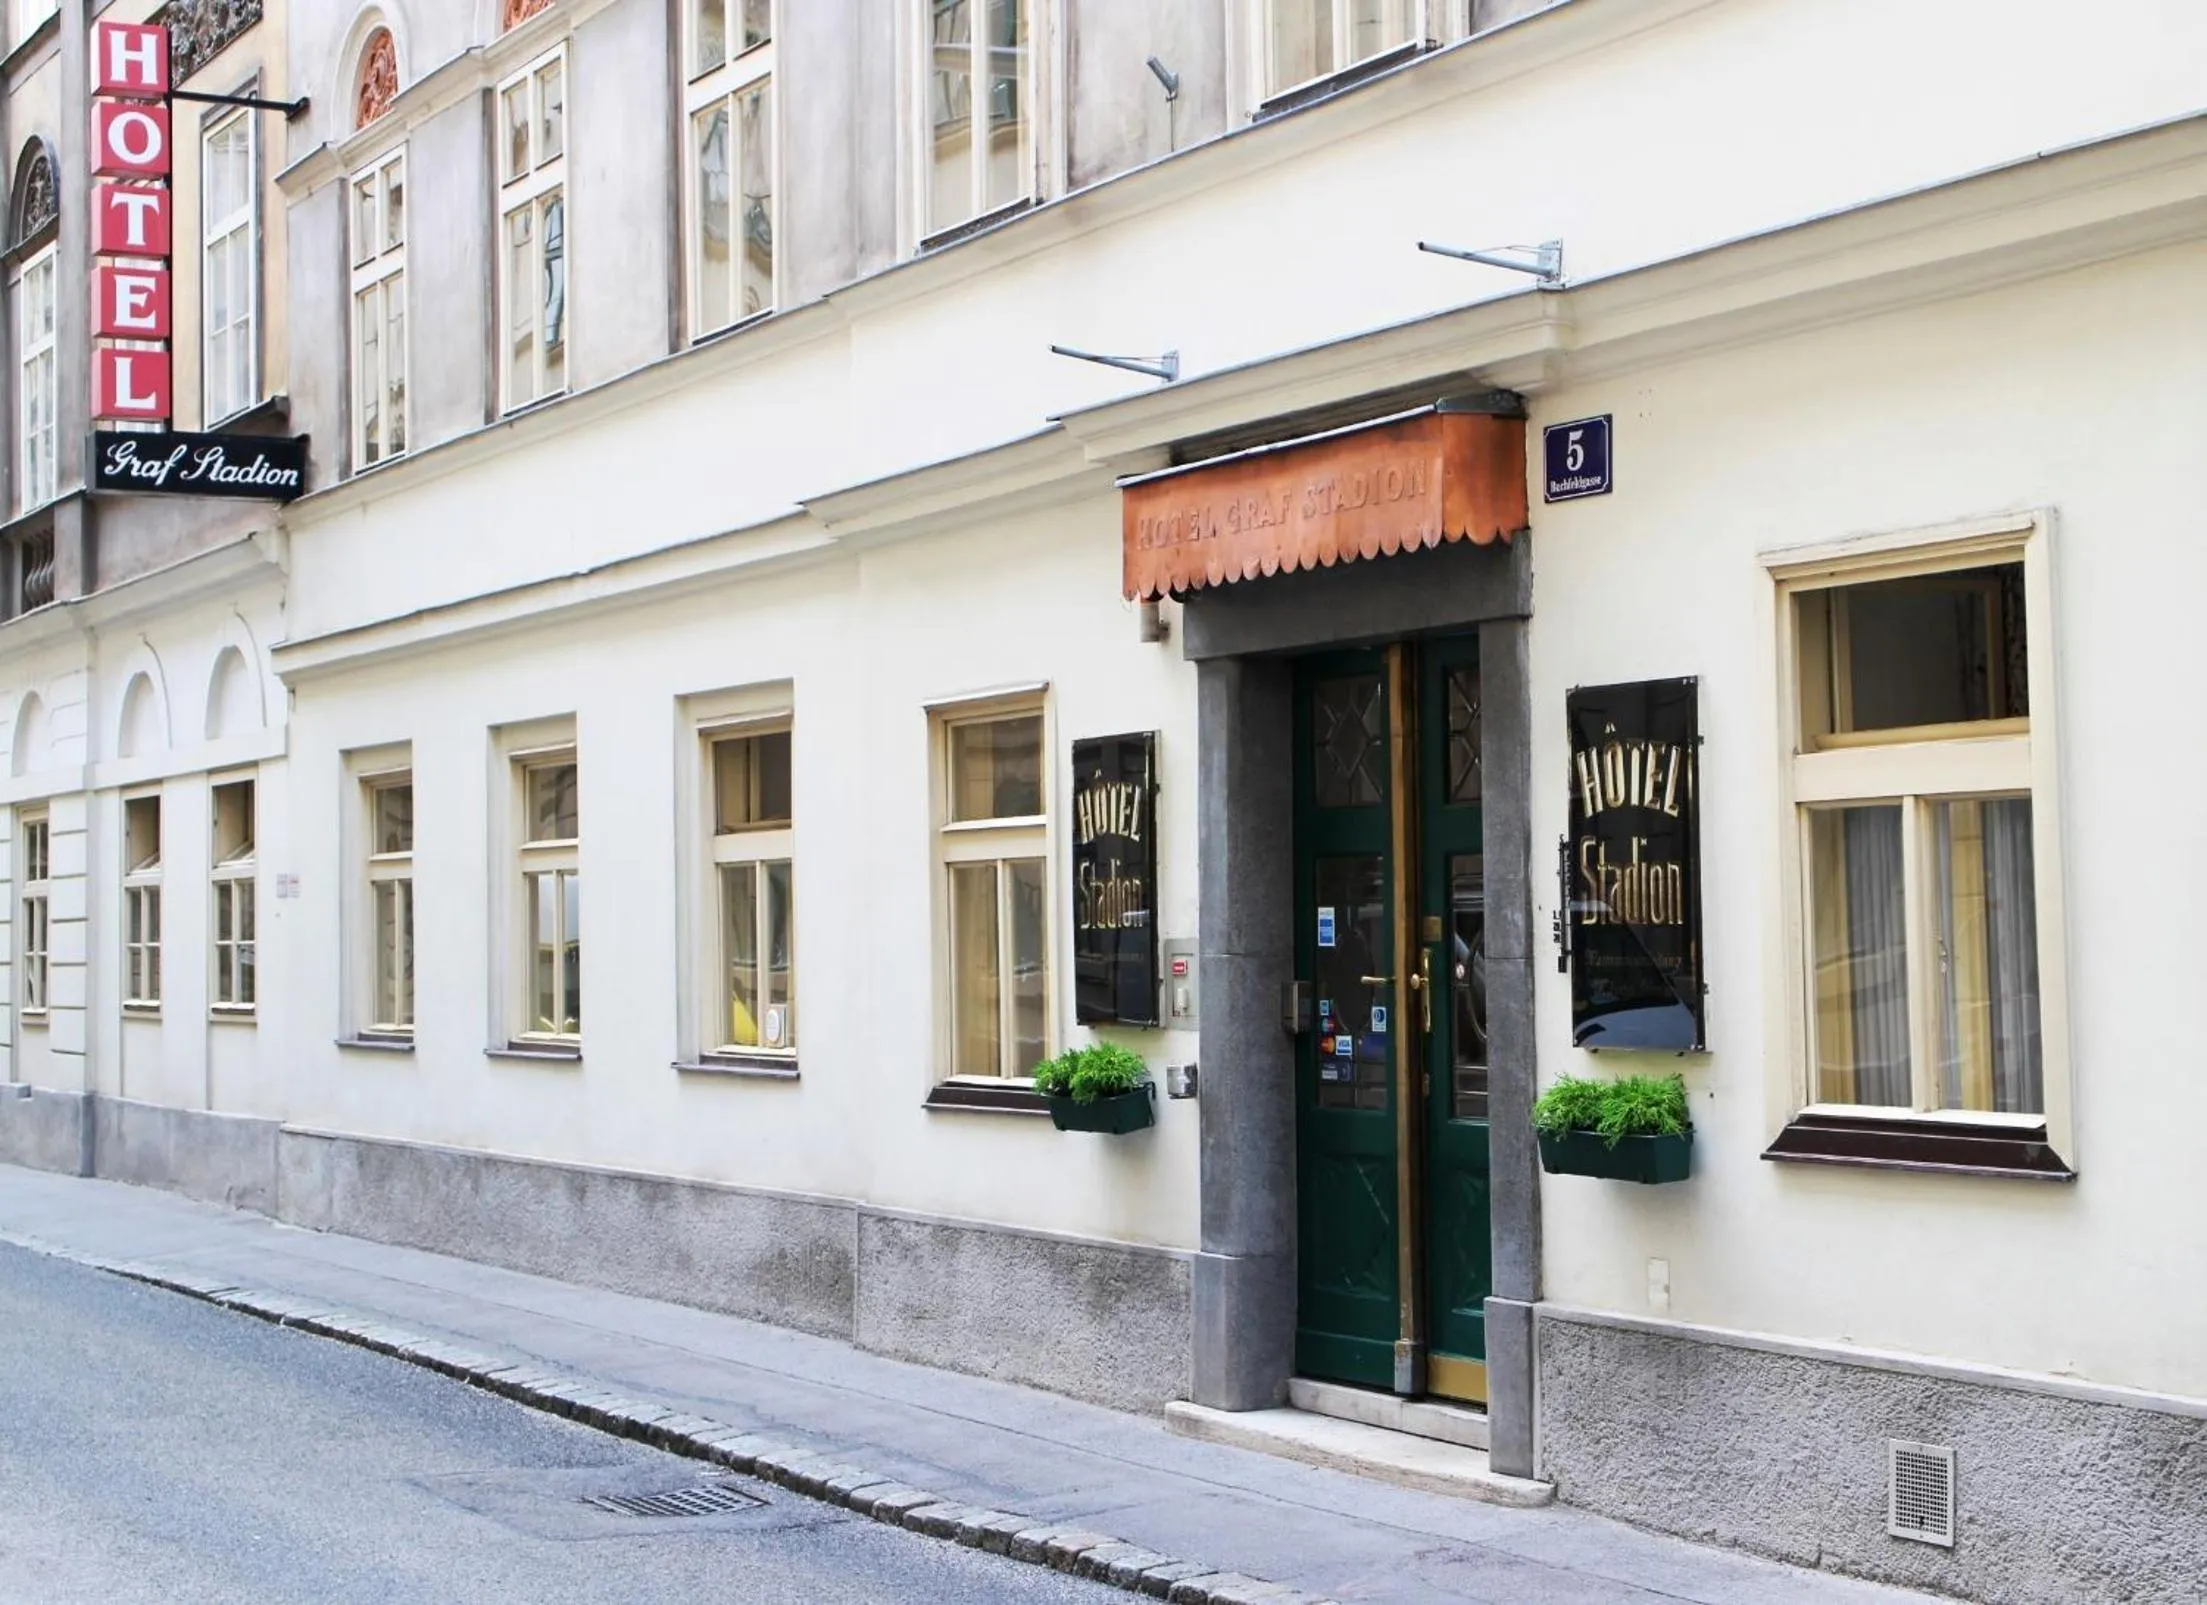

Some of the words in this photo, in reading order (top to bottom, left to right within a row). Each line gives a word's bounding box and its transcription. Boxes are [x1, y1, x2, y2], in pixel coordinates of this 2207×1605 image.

[108, 29, 162, 410] HOTEL
[104, 440, 188, 487] Graf
[180, 445, 299, 487] Stadion
[1566, 428, 1584, 472] 5
[1137, 504, 1217, 550] HOTEL
[1226, 489, 1292, 535] GRAF
[1303, 457, 1428, 520] STADION
[1079, 858, 1143, 929] Stadion
[1580, 836, 1684, 925] Stadion
